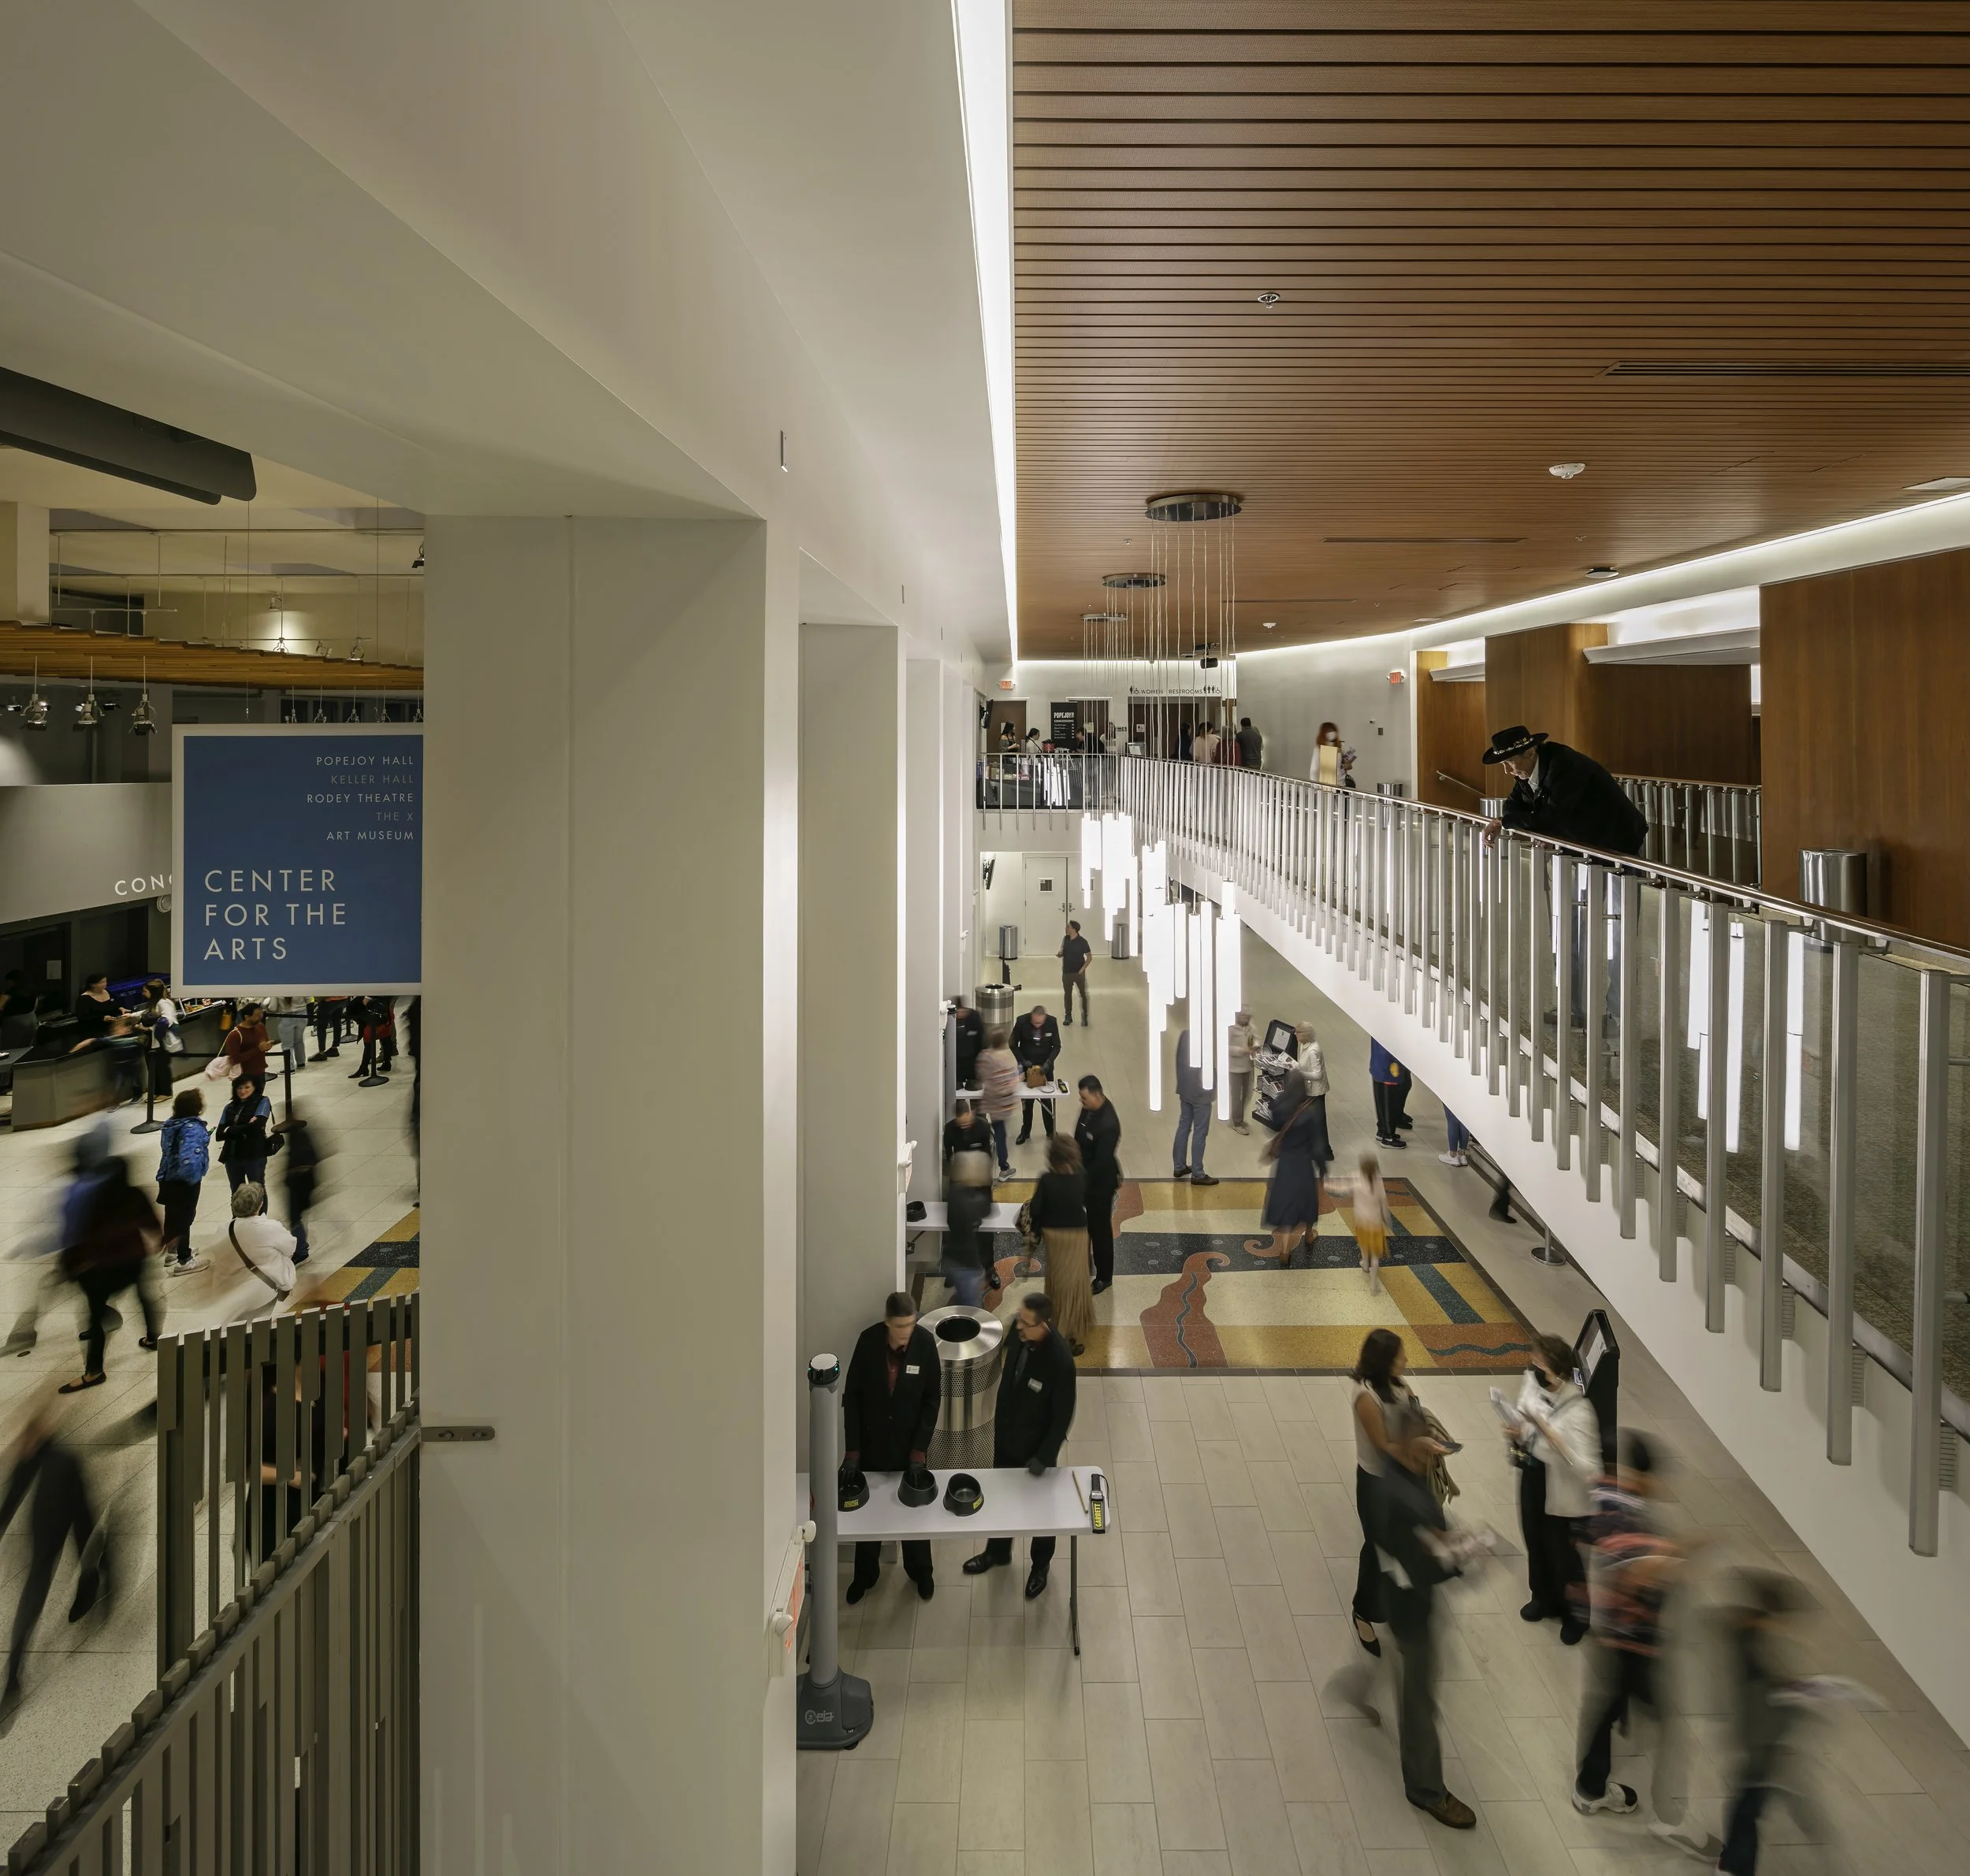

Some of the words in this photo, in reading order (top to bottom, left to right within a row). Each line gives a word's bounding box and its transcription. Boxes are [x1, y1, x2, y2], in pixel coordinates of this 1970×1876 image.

[316, 756, 375, 766] POPEJOY
[382, 756, 414, 765] HALL
[331, 775, 375, 785] KELLER
[383, 775, 414, 784] HALL
[307, 793, 351, 804] RODEY
[358, 793, 414, 802] THEATRE
[377, 812, 400, 821] THE
[407, 812, 414, 821] X
[326, 831, 350, 841] ART
[357, 830, 414, 841] MUSEUM
[114, 874, 172, 896] CON
[204, 869, 336, 893] CENTER
[205, 904, 270, 927] FOR
[285, 902, 347, 926] THE
[203, 937, 288, 961] ARTS
